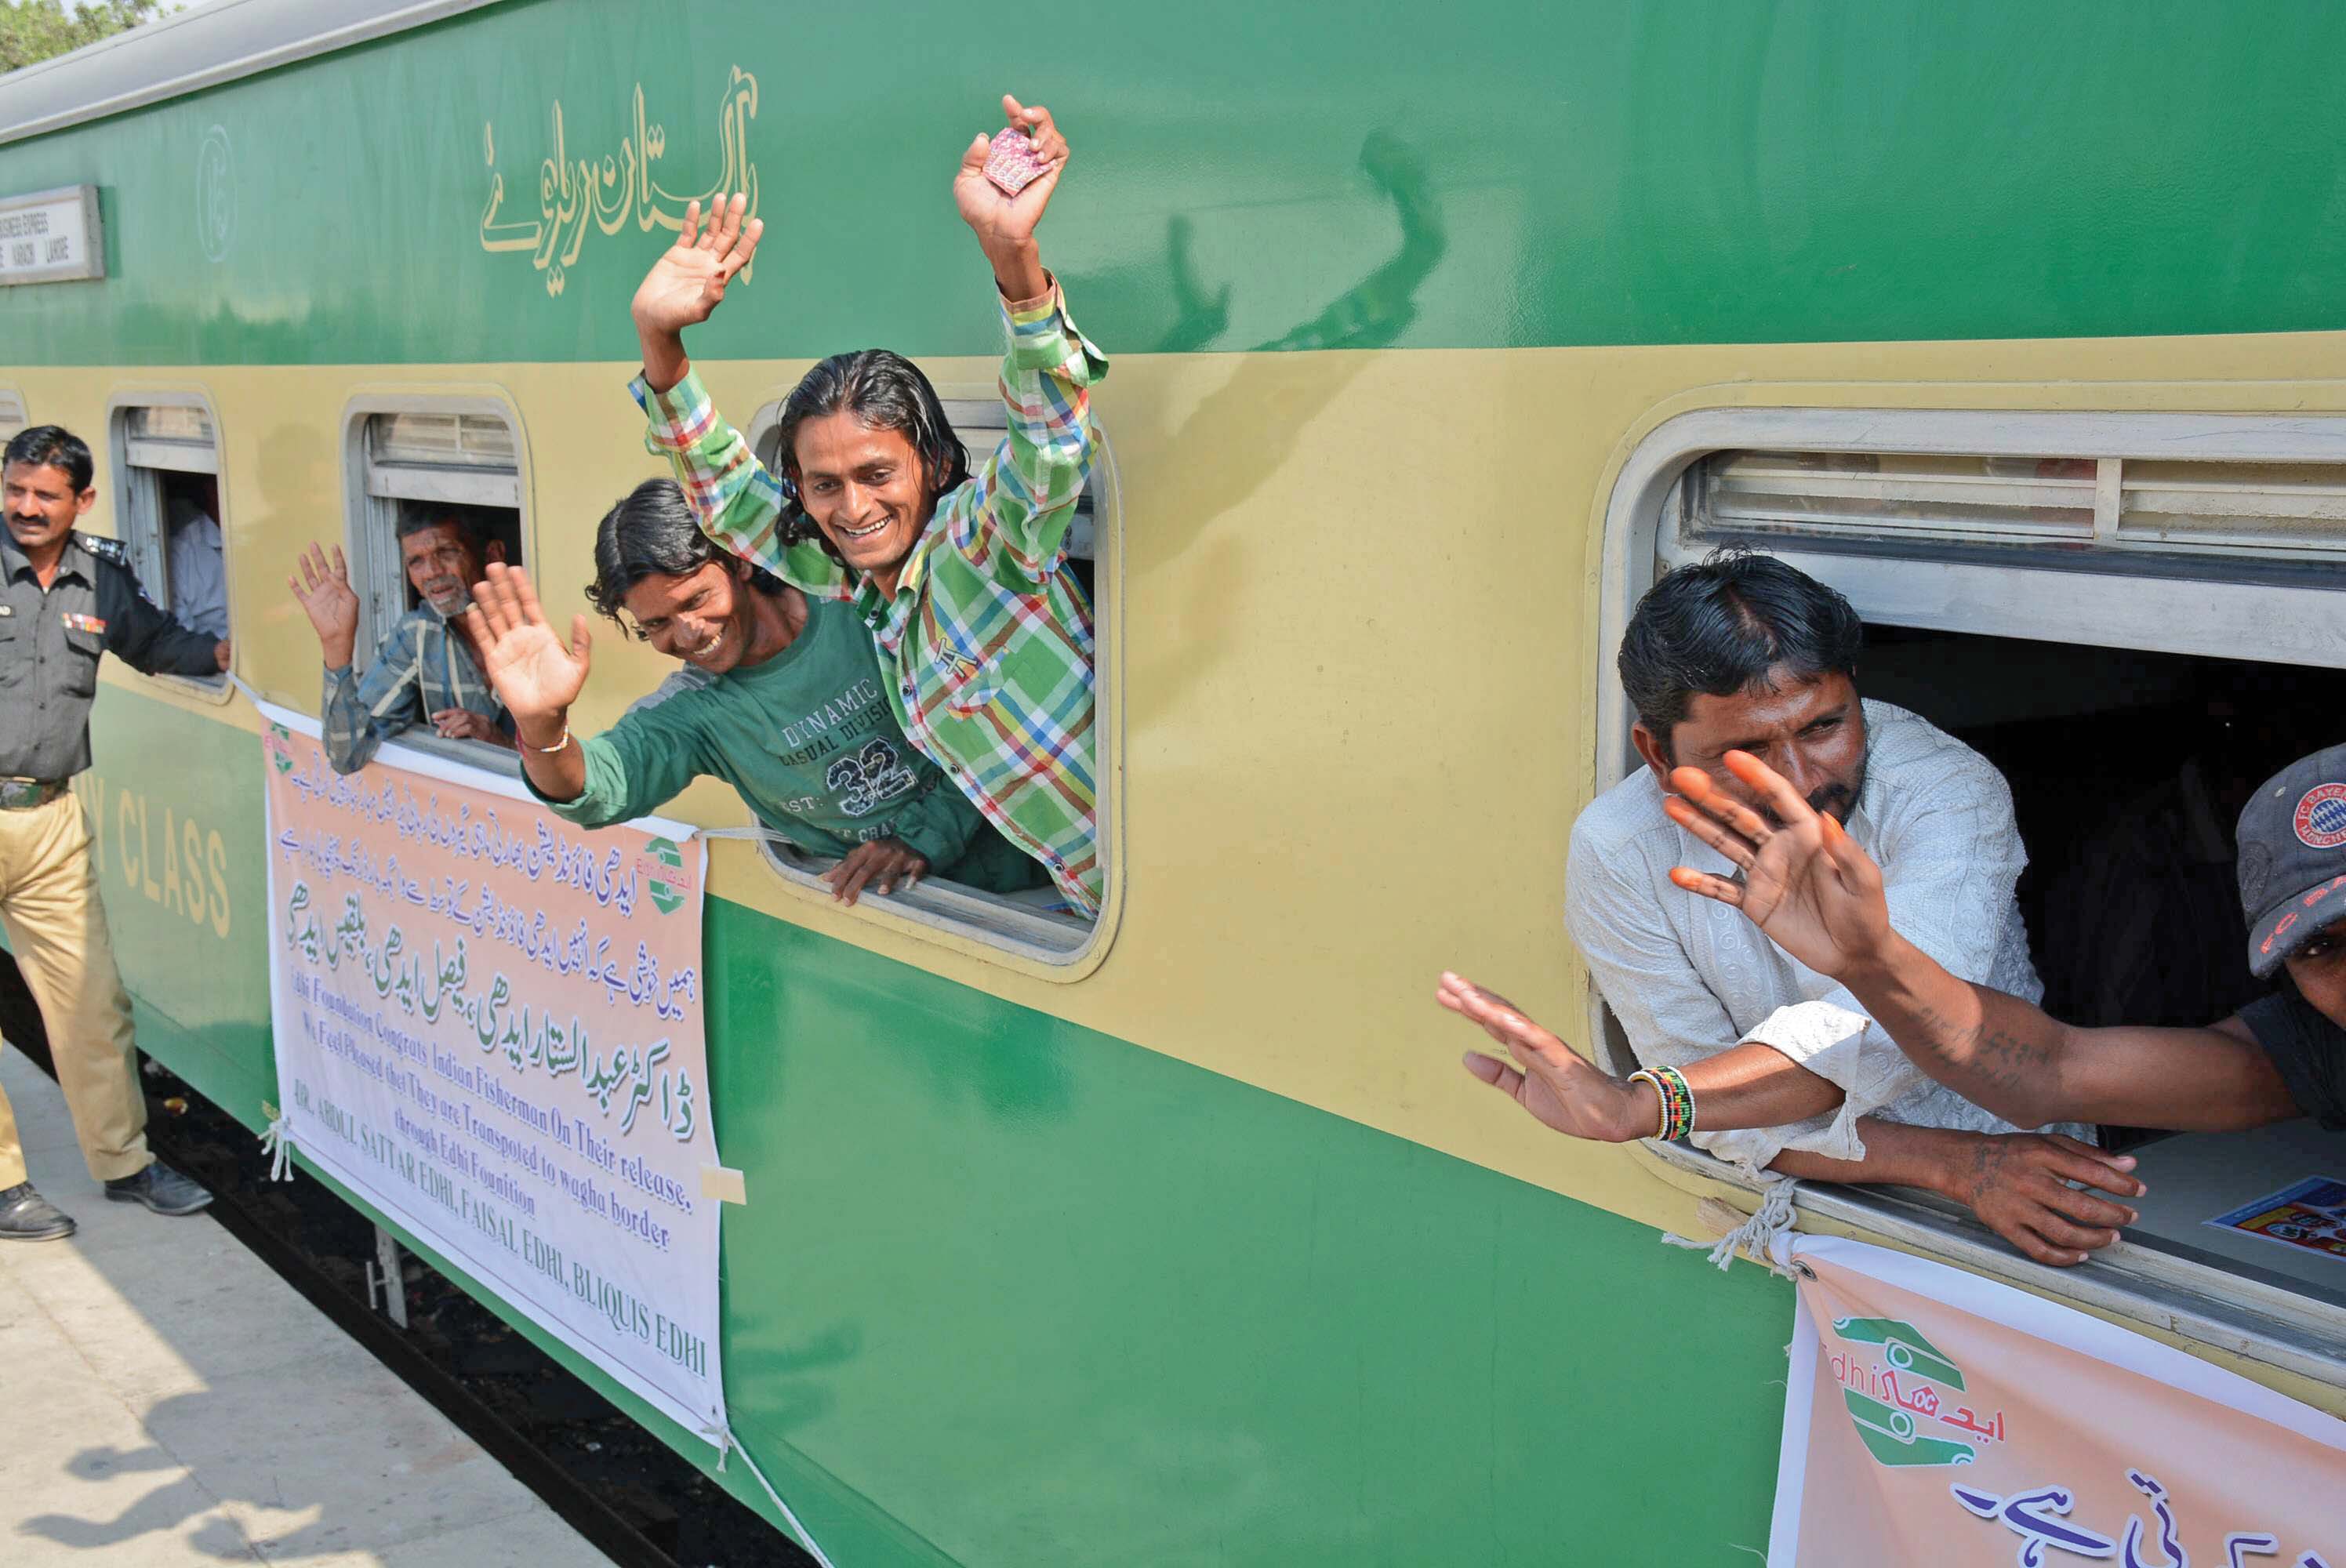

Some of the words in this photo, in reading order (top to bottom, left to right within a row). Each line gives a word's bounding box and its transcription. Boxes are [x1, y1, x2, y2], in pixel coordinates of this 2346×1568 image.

[778, 735, 840, 766] CASUAL
[782, 678, 877, 748] DYNAMIC
[826, 735, 919, 815] 32
[118, 788, 231, 939] CLASS
[595, 848, 637, 915] ایدھی
[288, 884, 323, 956] ایدھی
[326, 896, 365, 967] بلقیس
[420, 940, 470, 1028] فیصل
[602, 961, 628, 1003] ہے
[628, 941, 660, 1004] خوشی
[654, 958, 694, 1019] ہمیں
[530, 1013, 629, 1113] عبدالستار
[618, 1042, 692, 1134] ڈاکٹر
[318, 1018, 343, 1057] Feel
[408, 1071, 437, 1118] They
[439, 1097, 460, 1126] are
[463, 1102, 537, 1173] Transpoted
[541, 1153, 555, 1183] to
[559, 1162, 605, 1214] wagha
[611, 1190, 670, 1252] border
[375, 1008, 427, 1067] Congrats
[432, 1040, 473, 1091] Indian
[475, 1064, 547, 1132] Fisherman
[550, 1105, 570, 1145] On
[575, 1119, 616, 1170] Their
[620, 1145, 691, 1213] release.
[394, 1105, 438, 1156] through
[440, 1133, 467, 1173] Edhi
[470, 1150, 535, 1216] Founition
[317, 1093, 356, 1145] ABDUL
[360, 1120, 415, 1185] SATTAR
[460, 1186, 518, 1255] FAISAL
[572, 1259, 649, 1344] BLIQUIS
[655, 1310, 706, 1380] EDHI
[1821, 1341, 1878, 1396] dhi
